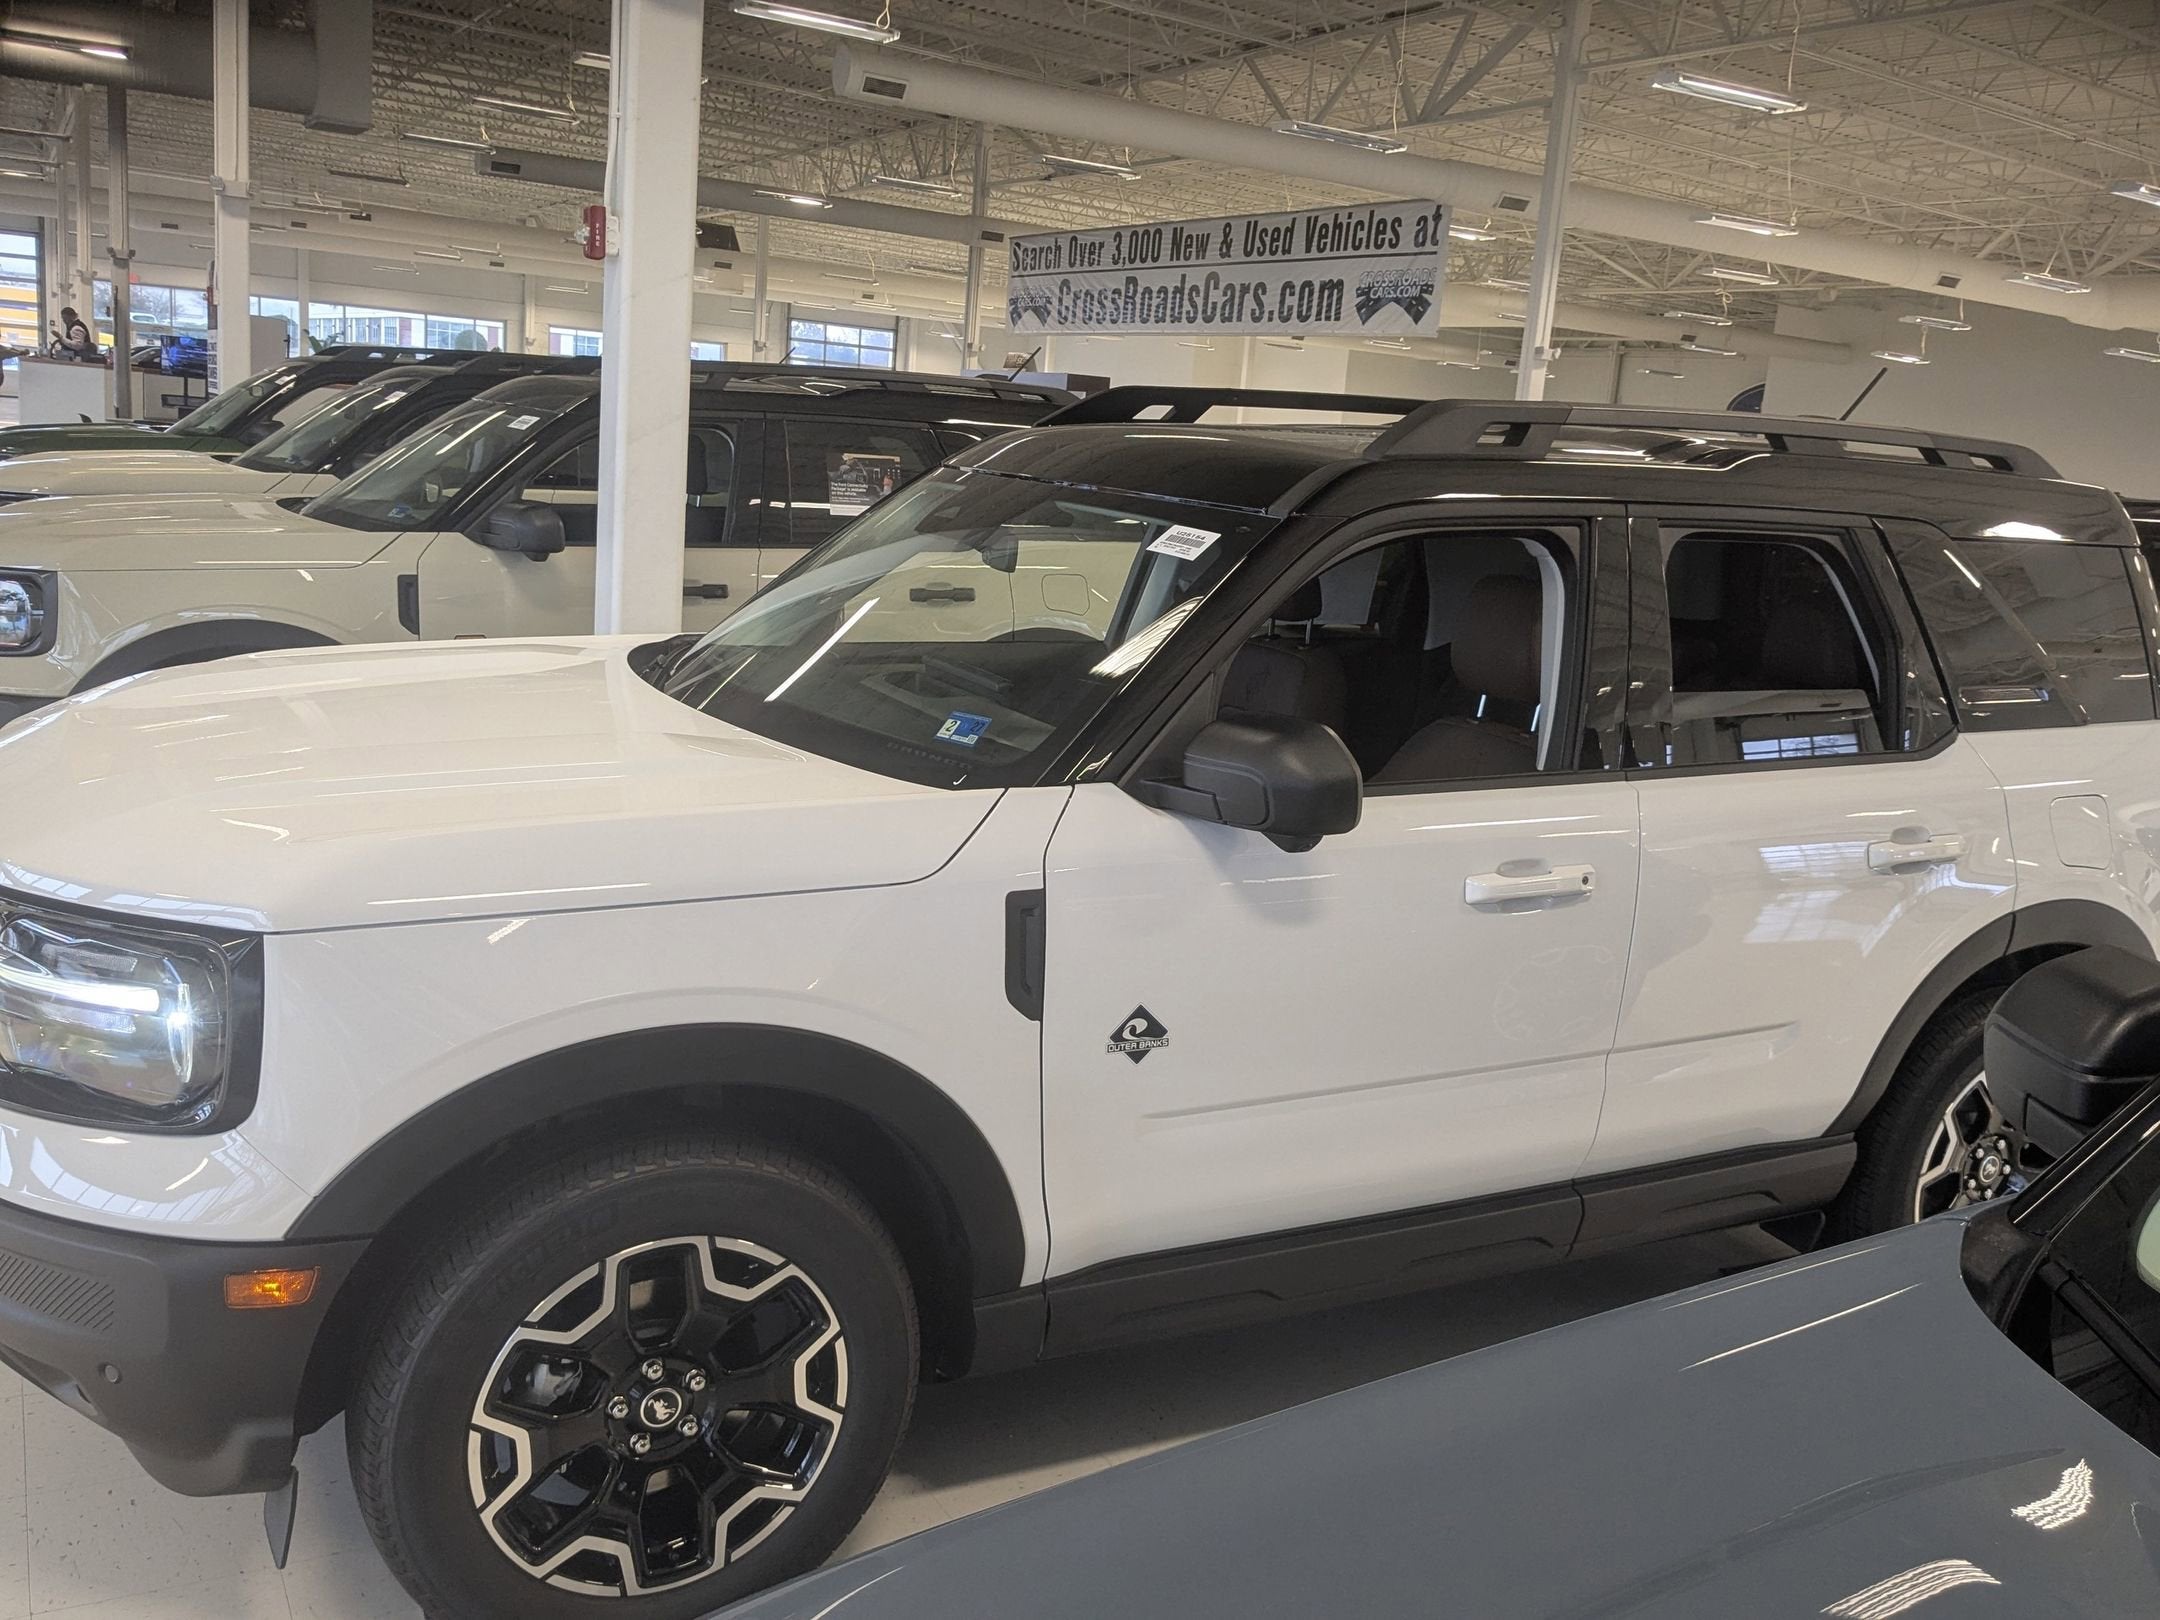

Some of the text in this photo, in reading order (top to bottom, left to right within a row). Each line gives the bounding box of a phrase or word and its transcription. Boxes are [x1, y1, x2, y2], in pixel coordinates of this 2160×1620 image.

[1012, 204, 1443, 272] Search Over 3,000 New & Used Vehicles at
[1359, 267, 1438, 288] CROSSROADS
[1056, 271, 1345, 325] CrossRoadsCars.com
[1369, 285, 1421, 299] CARS.COM
[944, 720, 958, 732] 2
[1108, 1039, 1168, 1052] OUTER BANKS
